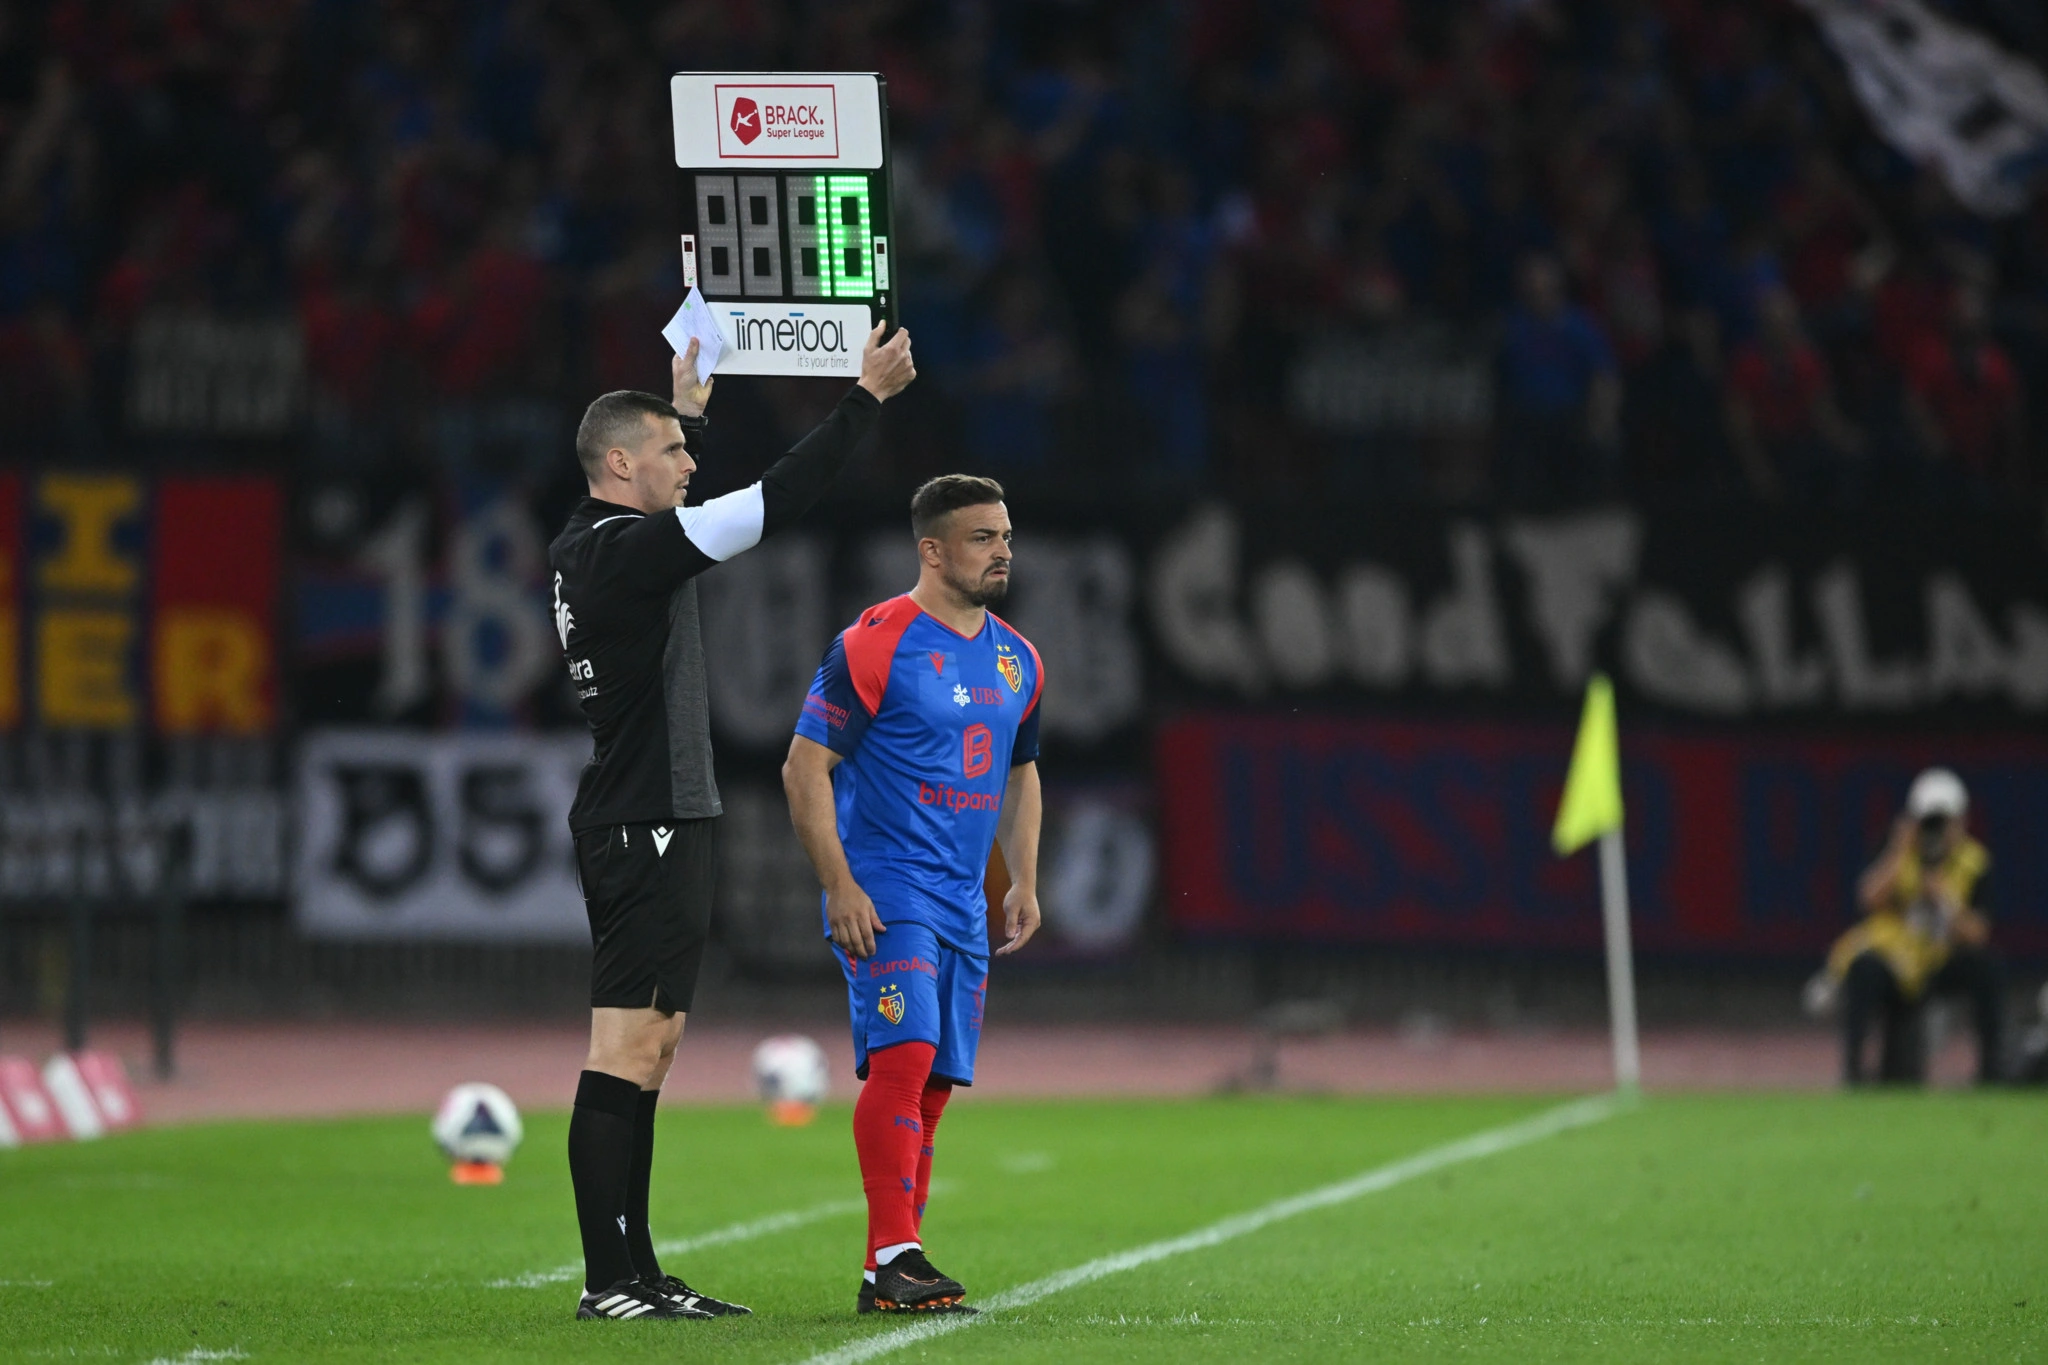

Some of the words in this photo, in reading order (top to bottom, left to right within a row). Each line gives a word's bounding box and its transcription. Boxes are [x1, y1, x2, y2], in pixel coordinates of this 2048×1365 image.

[765, 105, 824, 125] BRACK.
[767, 128, 792, 140] Super
[793, 127, 825, 140] League
[815, 175, 874, 298] 10
[797, 354, 809, 367] it's
[811, 357, 829, 370] your
[830, 355, 849, 368] time
[971, 687, 1004, 706] UBS
